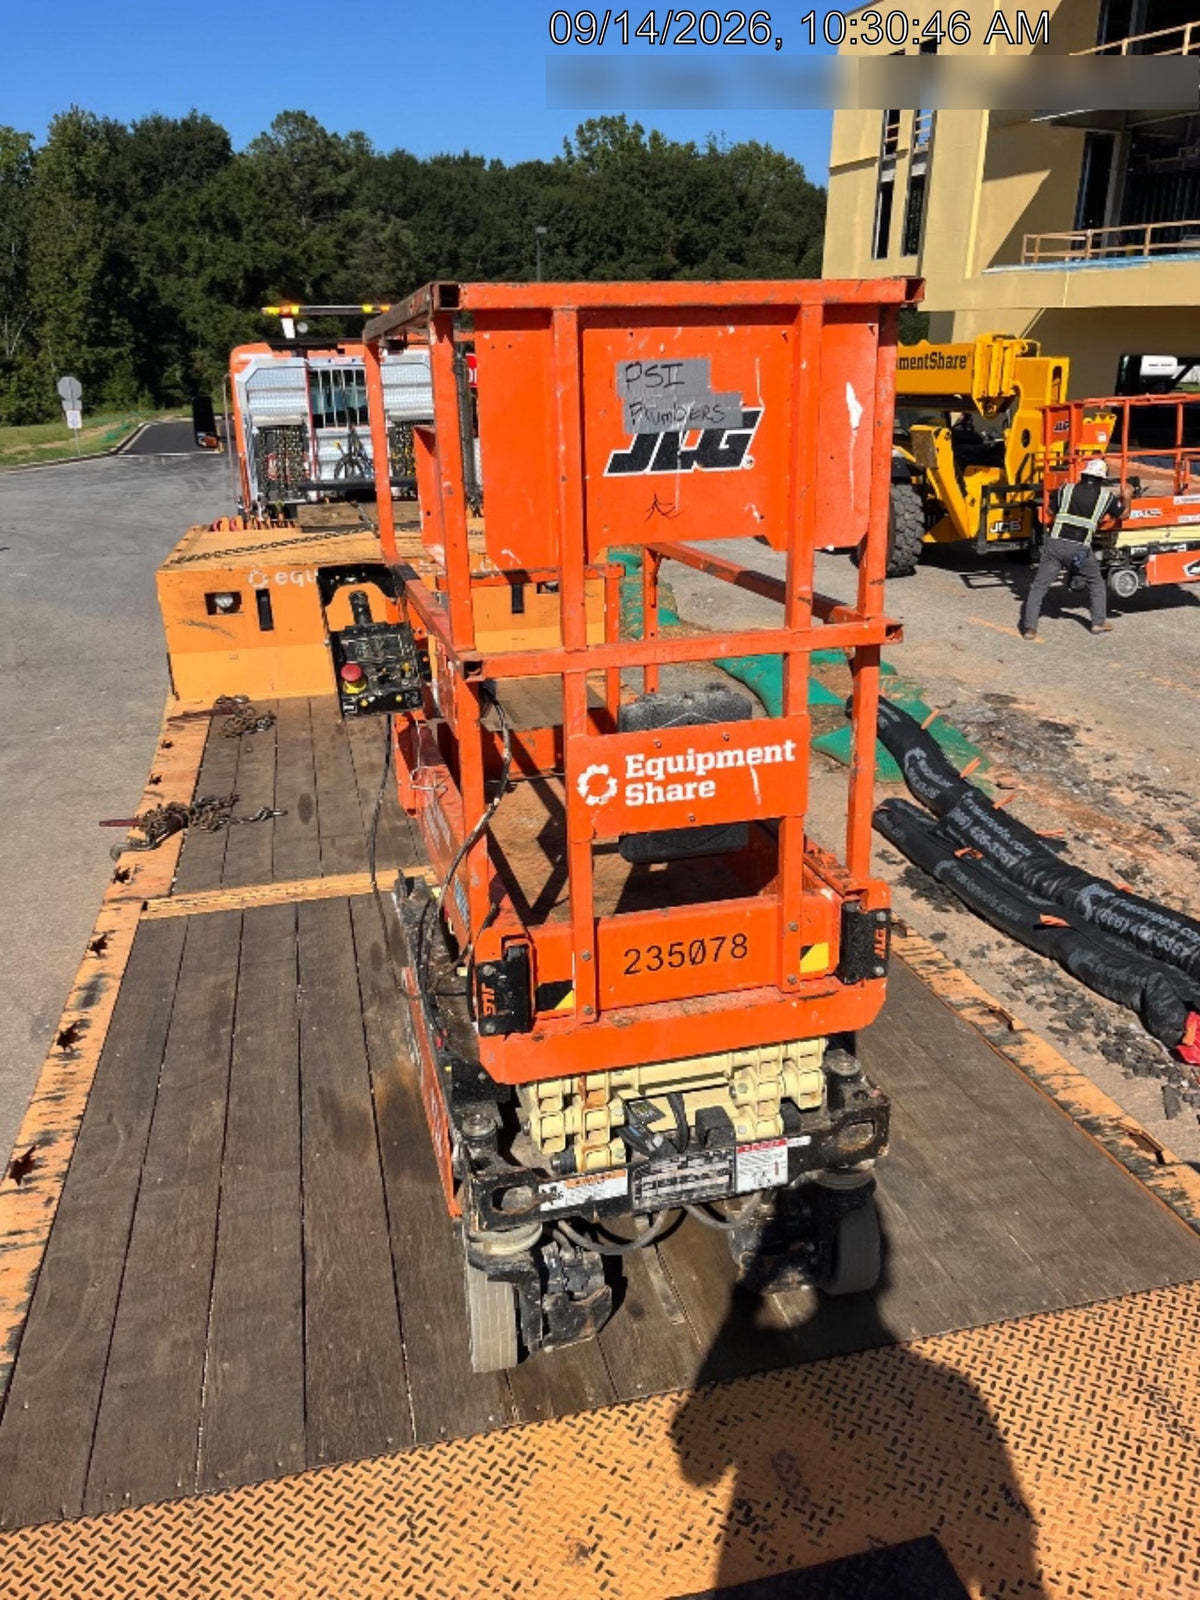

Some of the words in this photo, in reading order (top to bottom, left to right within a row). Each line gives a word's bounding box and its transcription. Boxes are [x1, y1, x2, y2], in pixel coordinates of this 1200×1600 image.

[625, 361, 685, 390] PSI
[896, 352, 966, 370] mentShare
[603, 407, 765, 477] JLG
[625, 739, 796, 780] Equipment
[625, 779, 716, 807] Share
[624, 933, 748, 975] 235078
[873, 927, 887, 960] JLG
[481, 982, 497, 1017] JLG
